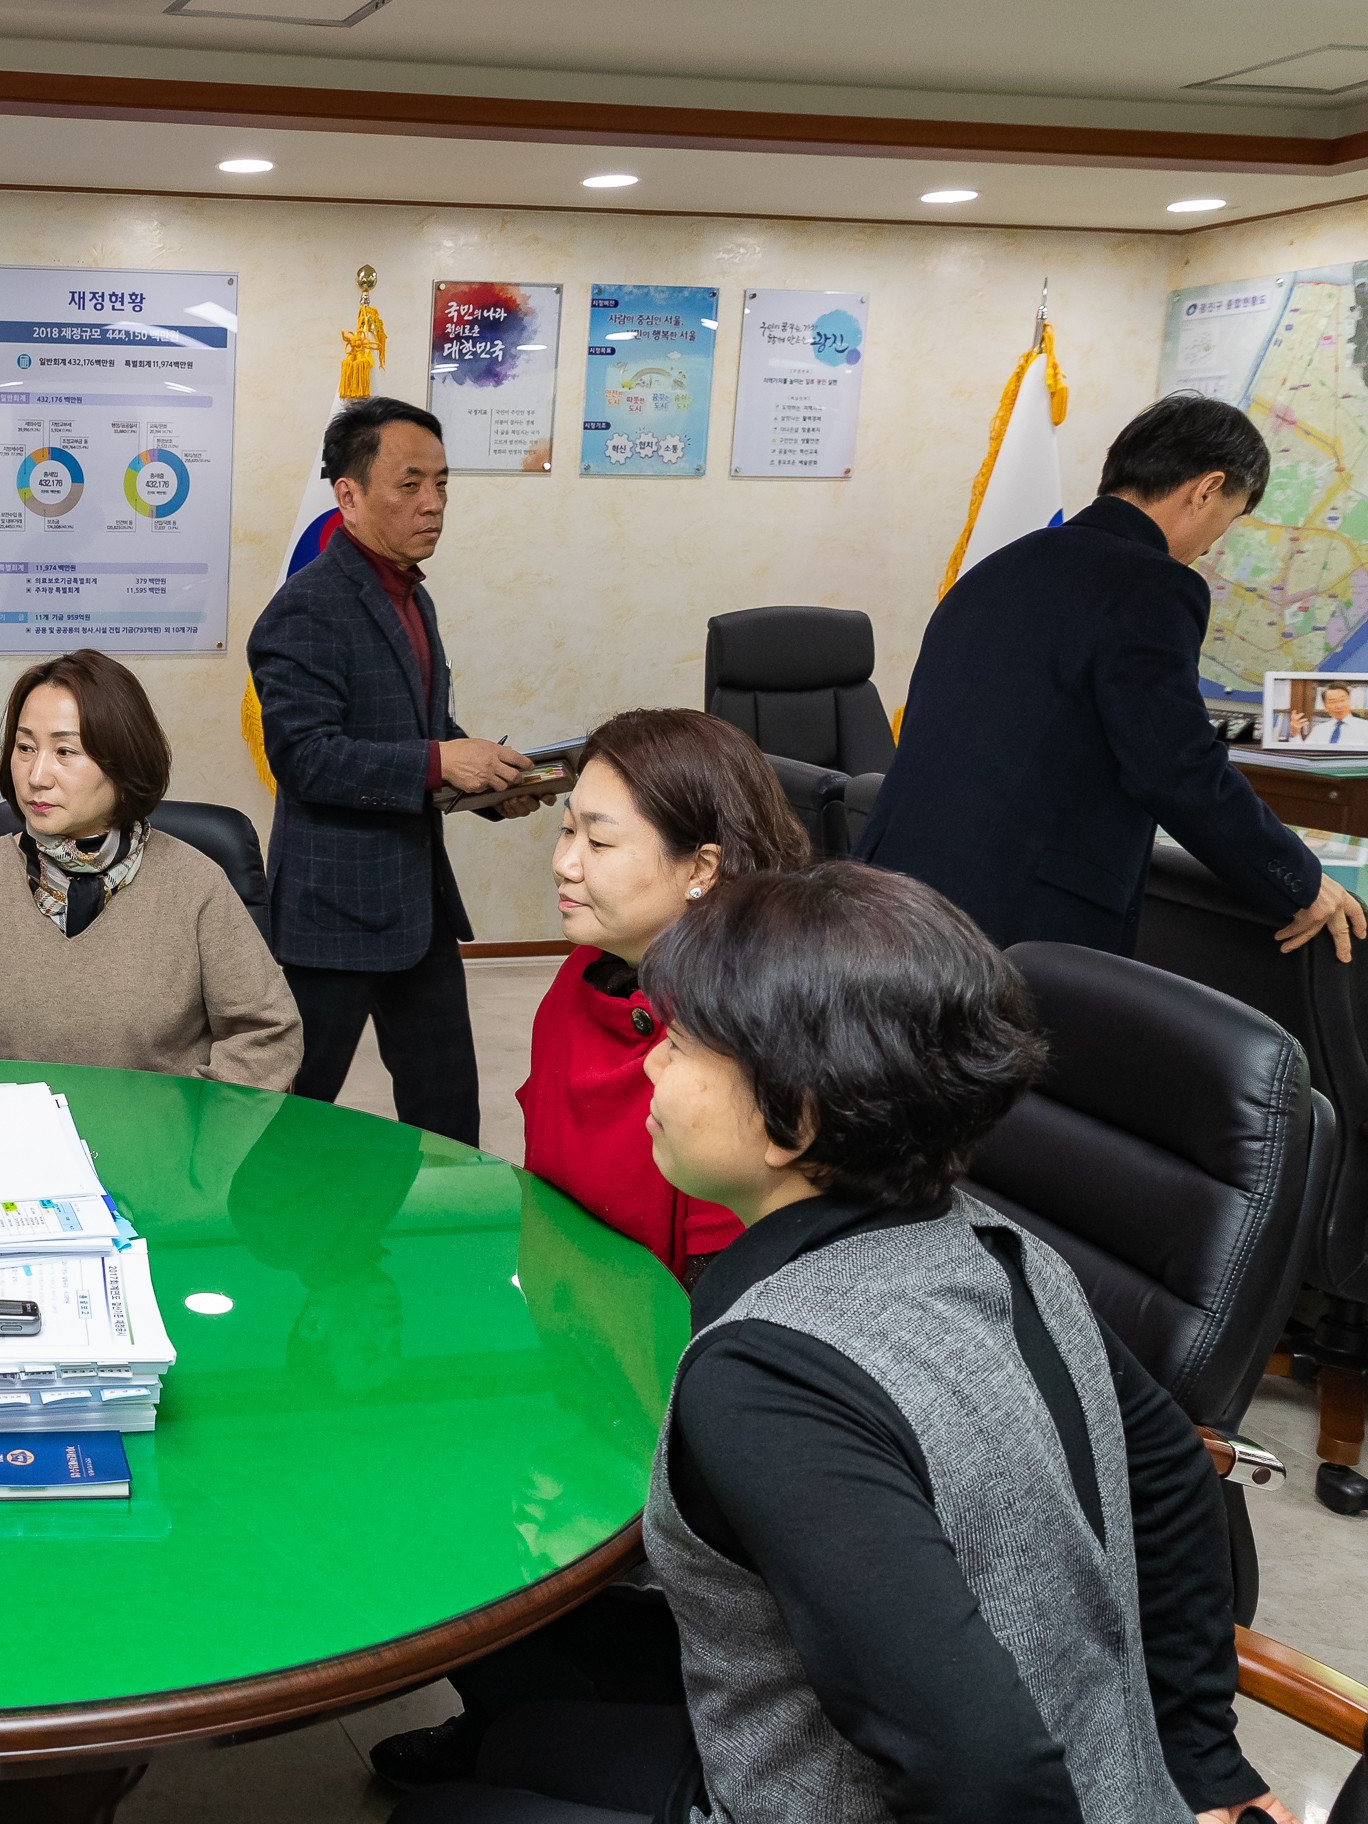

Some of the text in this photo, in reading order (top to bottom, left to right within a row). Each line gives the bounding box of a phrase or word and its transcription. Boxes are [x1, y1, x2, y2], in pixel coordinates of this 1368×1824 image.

[68, 290, 146, 313] 재정현황
[444, 301, 507, 322] 국민의 나라
[609, 314, 684, 327] 사람이 중심인 서울,
[33, 327, 179, 342] 2018 재정규모 444,150 백만원
[445, 323, 480, 338] 정의로운
[652, 330, 677, 341] 행복한
[679, 330, 696, 342] 서울
[810, 331, 849, 353] 광진
[443, 339, 505, 362] 대한민국
[39, 357, 66, 366] 일반회계
[125, 359, 151, 368] 특별회계
[607, 398, 621, 406] 도시
[654, 402, 667, 410] 도시
[676, 402, 690, 410] 도시
[612, 444, 627, 453] 혁신
[638, 441, 653, 450] 협치
[664, 444, 678, 454] 소통
[108, 1265, 121, 1300] 2017회계연도
